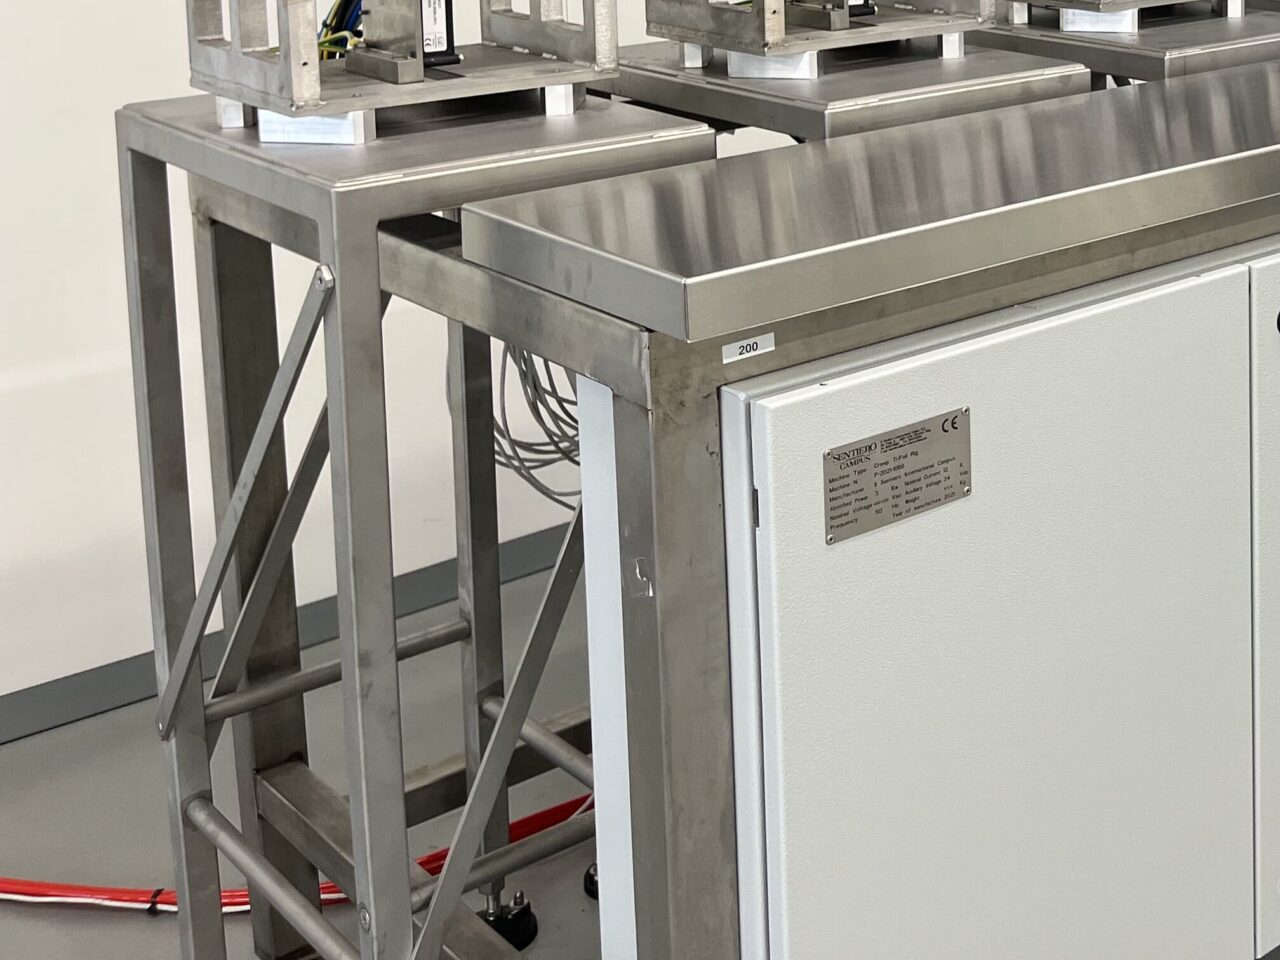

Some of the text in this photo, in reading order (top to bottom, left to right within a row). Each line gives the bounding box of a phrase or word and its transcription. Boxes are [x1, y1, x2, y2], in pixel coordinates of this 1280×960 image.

[738, 342, 759, 355] 200
[833, 442, 877, 461] SENTIERO
[840, 455, 871, 470] CAMPUS
